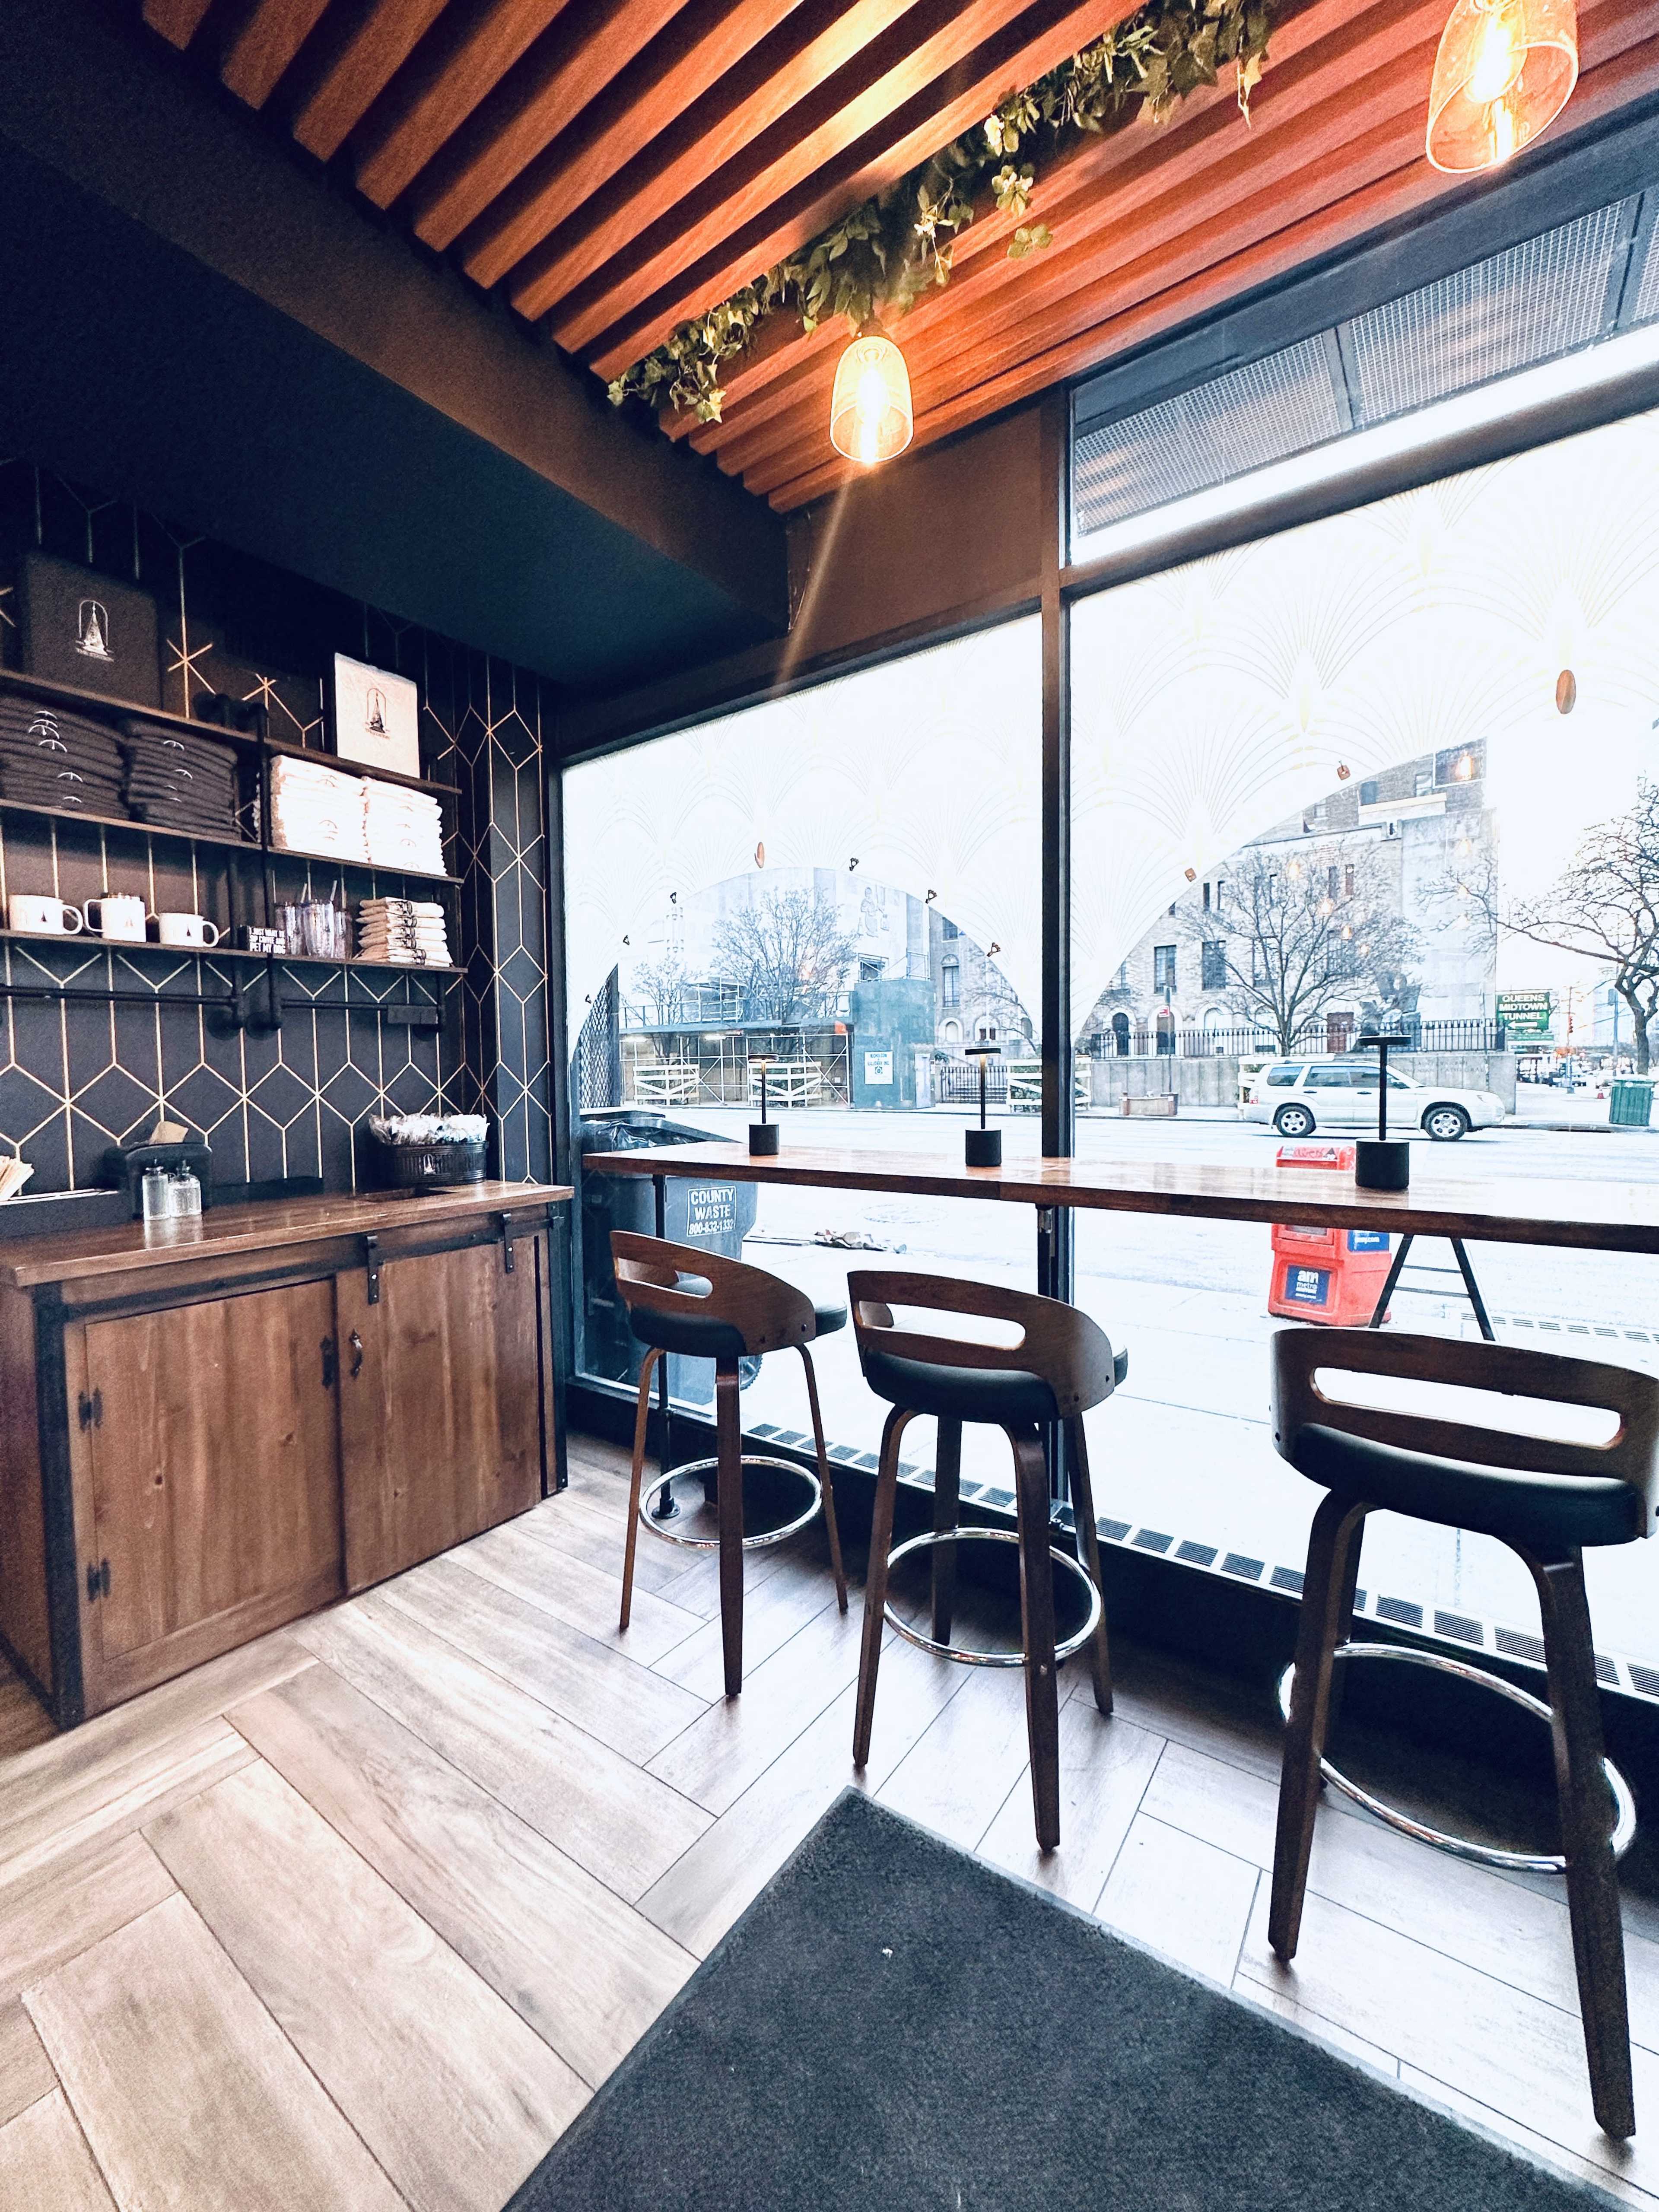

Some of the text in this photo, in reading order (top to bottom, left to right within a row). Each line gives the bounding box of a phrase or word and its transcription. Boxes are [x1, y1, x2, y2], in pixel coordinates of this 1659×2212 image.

[250, 942, 286, 954] PET MY DOG
[1502, 994, 1545, 1002] QUEENS
[1499, 1002, 1548, 1011] MIDTOWN
[1503, 1011, 1544, 1020] TUNNEL
[691, 1189, 734, 1205] COUNTY
[694, 1204, 731, 1220] WASTE
[689, 1218, 734, 1235] 800-632-1332
[1297, 1270, 1319, 1284] am
[1297, 1281, 1318, 1290] metro
